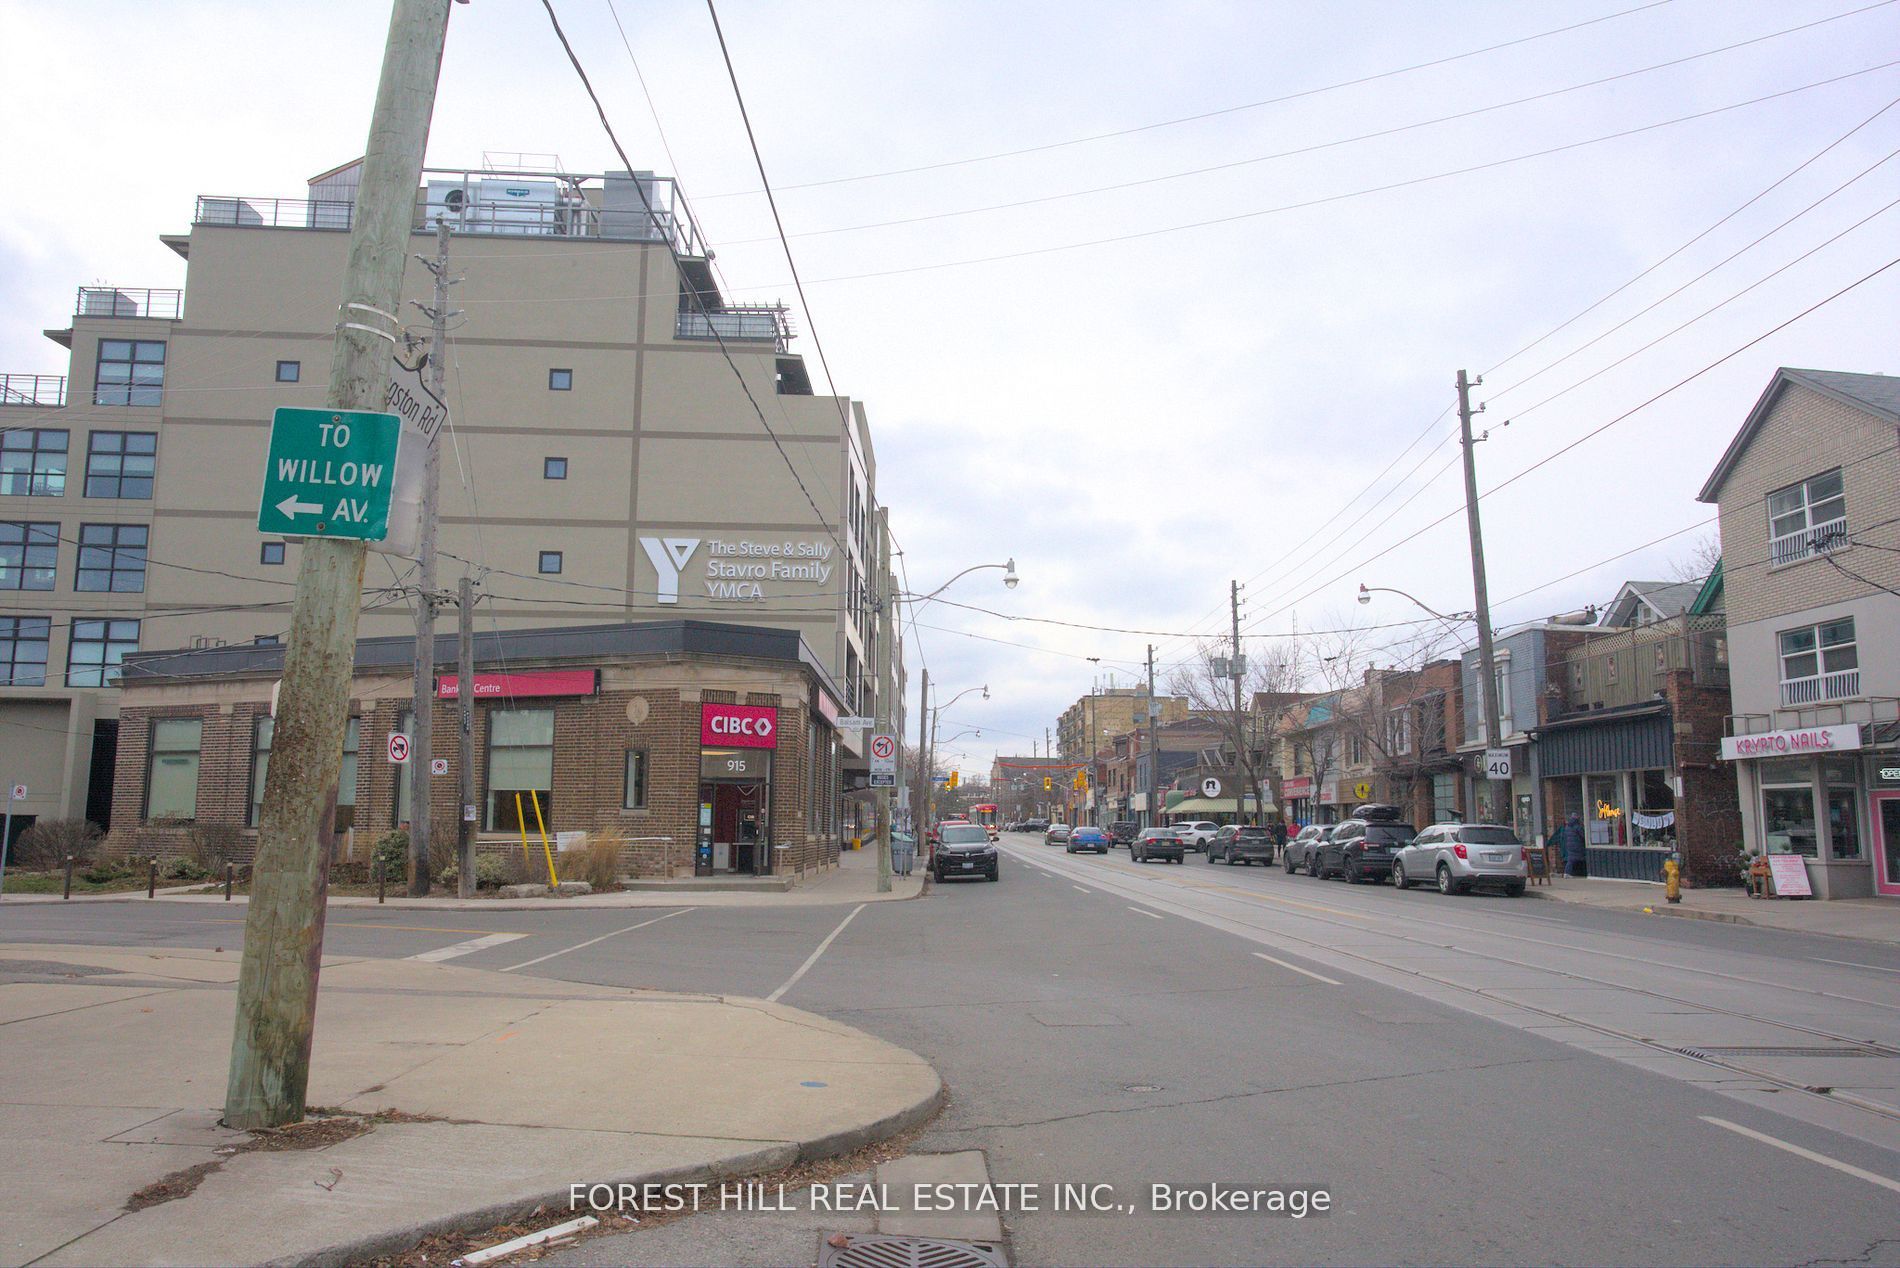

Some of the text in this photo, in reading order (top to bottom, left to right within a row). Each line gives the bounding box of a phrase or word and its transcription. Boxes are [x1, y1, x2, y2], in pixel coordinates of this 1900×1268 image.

[386, 378, 439, 435] gston Rd
[318, 423, 350, 448] TO
[278, 458, 383, 487] WILLOW
[331, 498, 369, 523] AV.
[709, 541, 832, 561] The Steve & Sally
[707, 560, 832, 585] Stavro Family
[706, 582, 763, 599] YMCA
[473, 683, 500, 693] Centre
[710, 715, 753, 735] CIBC
[1736, 730, 1830, 754] KRYPTO NAILS
[727, 760, 746, 772] 915
[1488, 761, 1509, 775] 40
